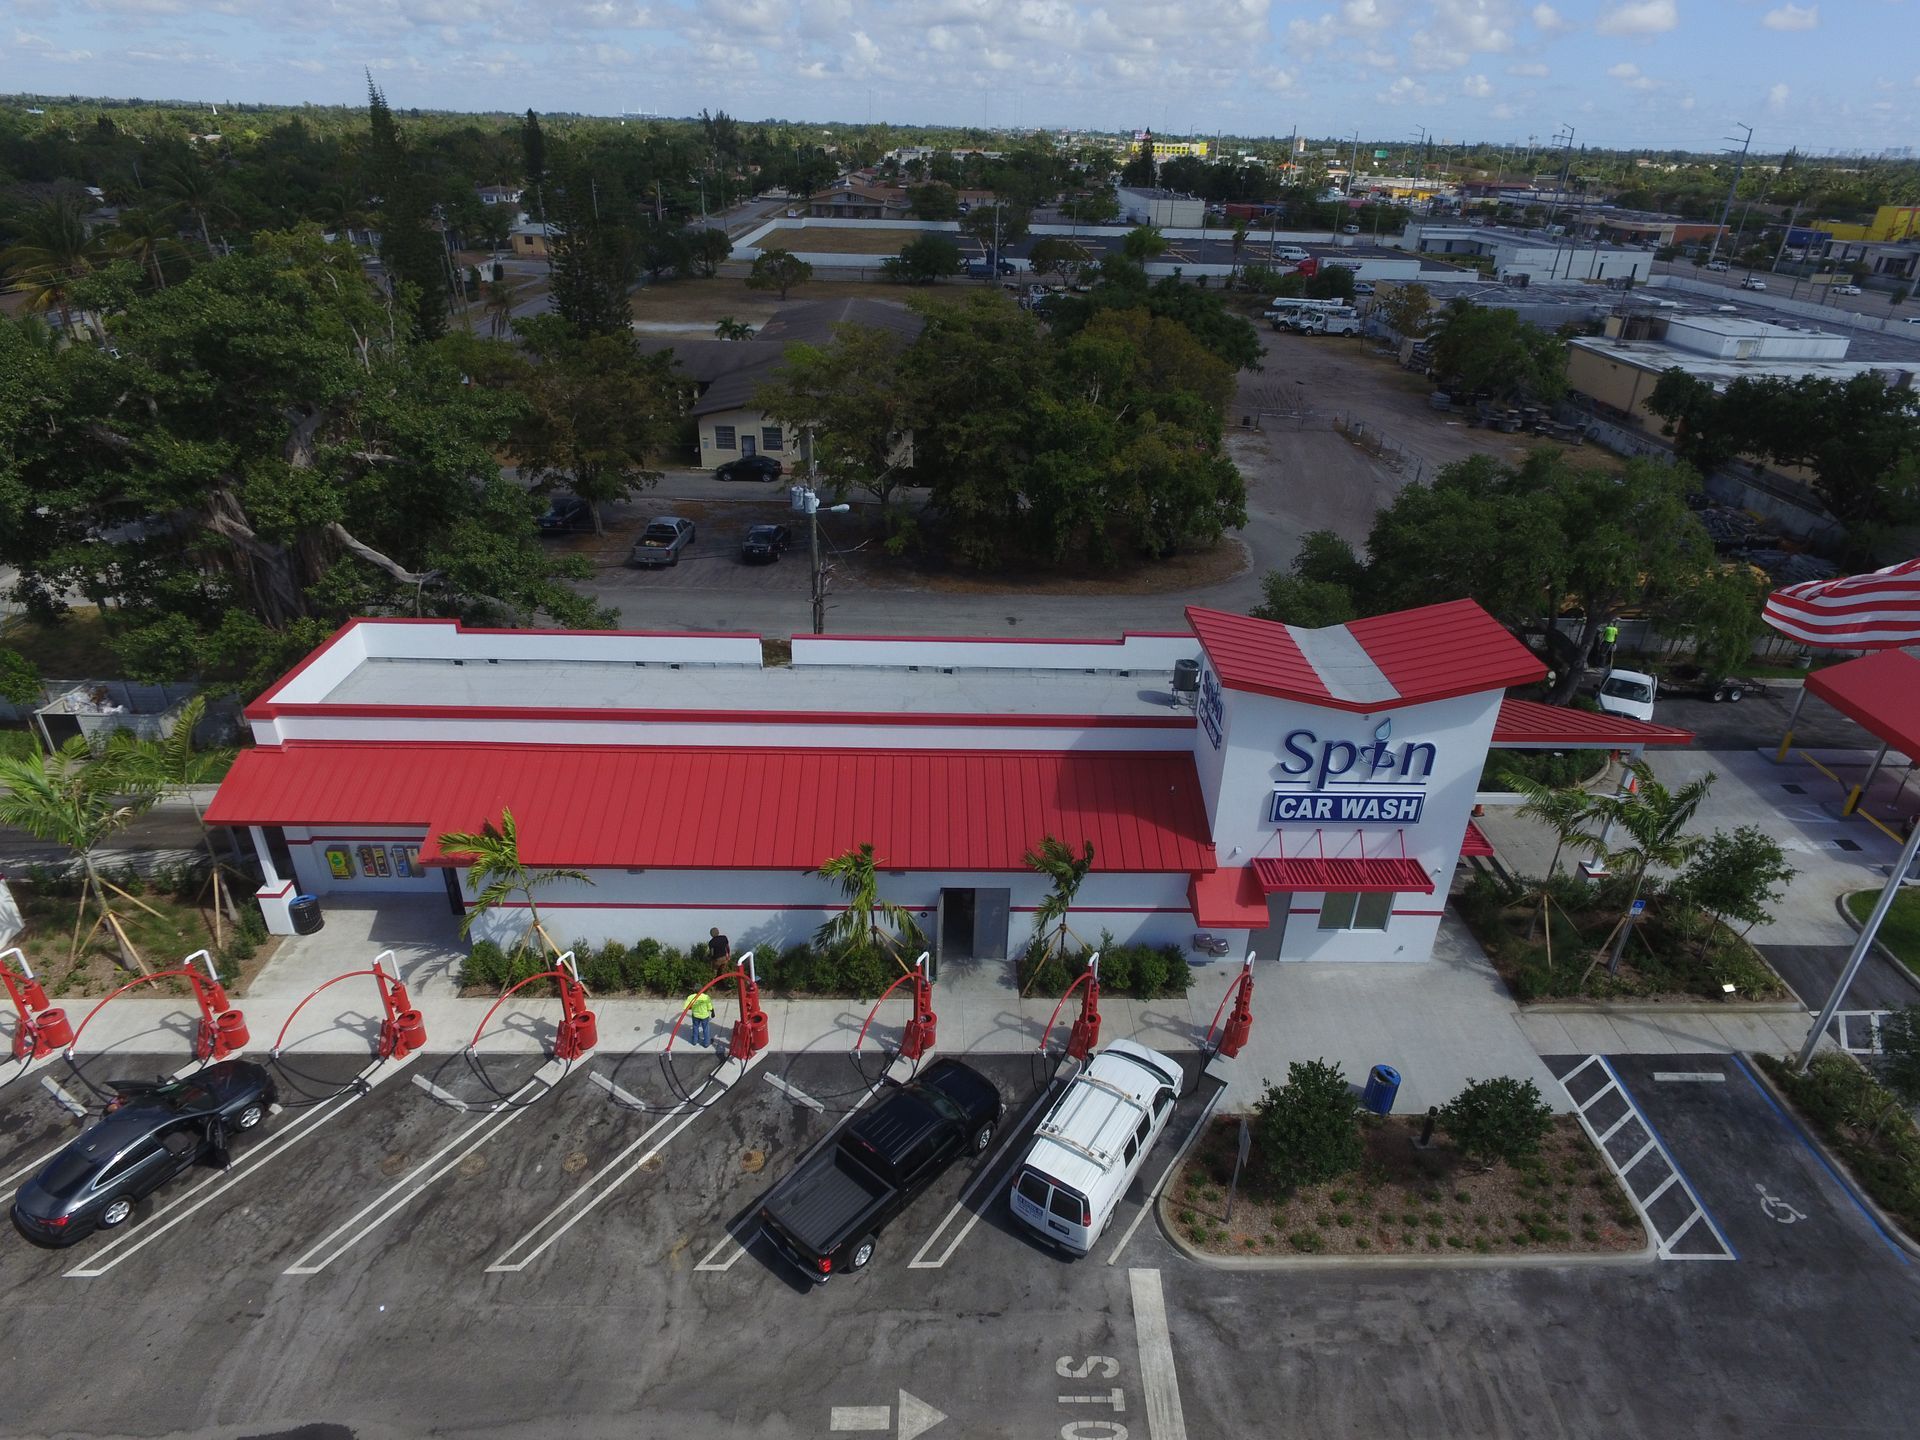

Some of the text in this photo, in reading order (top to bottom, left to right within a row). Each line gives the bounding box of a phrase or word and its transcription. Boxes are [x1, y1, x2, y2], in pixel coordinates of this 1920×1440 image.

[1280, 717, 1437, 789] Spin
[1279, 798, 1419, 820] CAR WASH
